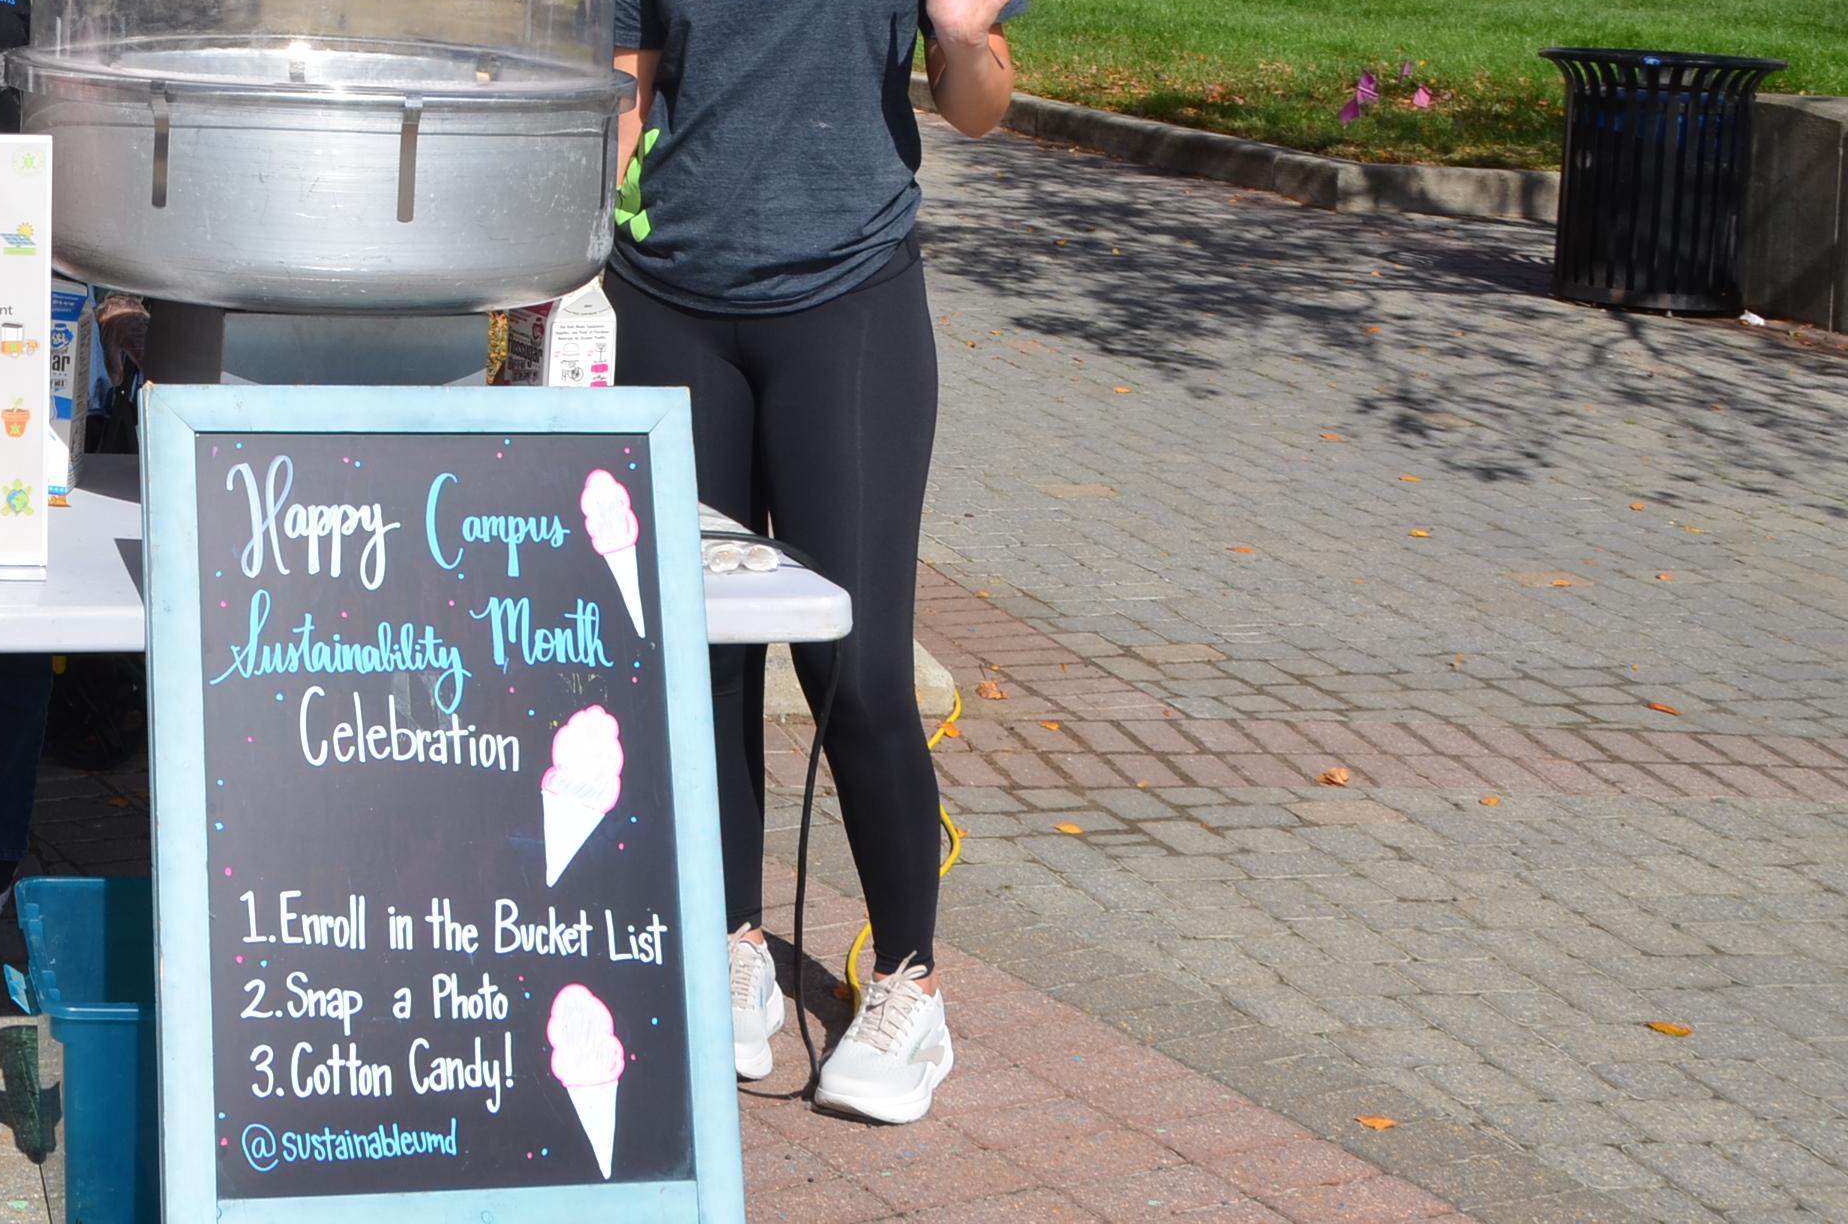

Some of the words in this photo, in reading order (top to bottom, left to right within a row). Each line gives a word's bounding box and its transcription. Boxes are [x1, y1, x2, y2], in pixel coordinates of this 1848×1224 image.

[226, 455, 401, 590] Happy
[425, 473, 572, 577] Campus
[210, 589, 472, 714] Sustainability
[469, 597, 614, 669] Month
[299, 686, 520, 772] Celebration
[387, 906, 414, 951] in
[425, 898, 479, 954] the
[494, 898, 593, 957] Bucket
[605, 909, 668, 965] List
[392, 987, 412, 1020] a
[432, 973, 509, 1021] Photo
[408, 1032, 515, 1114] Candy!
[241, 1117, 458, 1172] @sustainableumd
